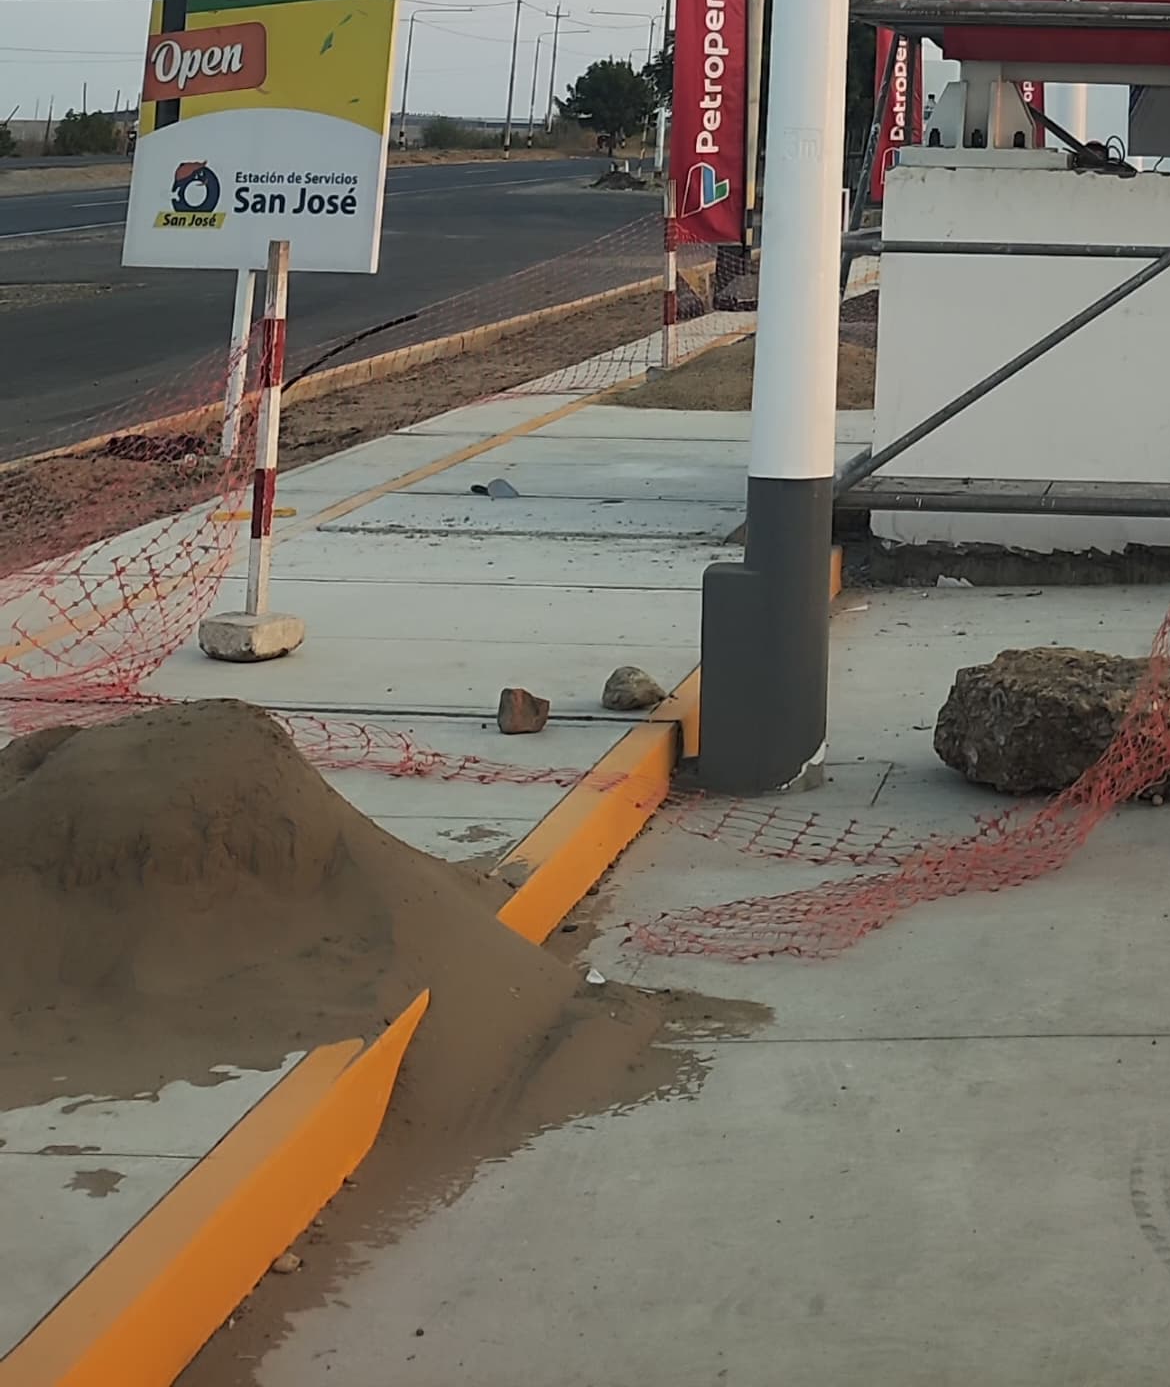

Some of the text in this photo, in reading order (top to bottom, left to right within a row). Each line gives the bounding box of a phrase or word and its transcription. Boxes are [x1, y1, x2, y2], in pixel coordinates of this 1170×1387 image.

[151, 39, 243, 90] Open
[889, 35, 908, 141] Petroper
[235, 171, 358, 185] Estación de Servicios
[234, 187, 357, 215] San José
[163, 214, 216, 227] San José
